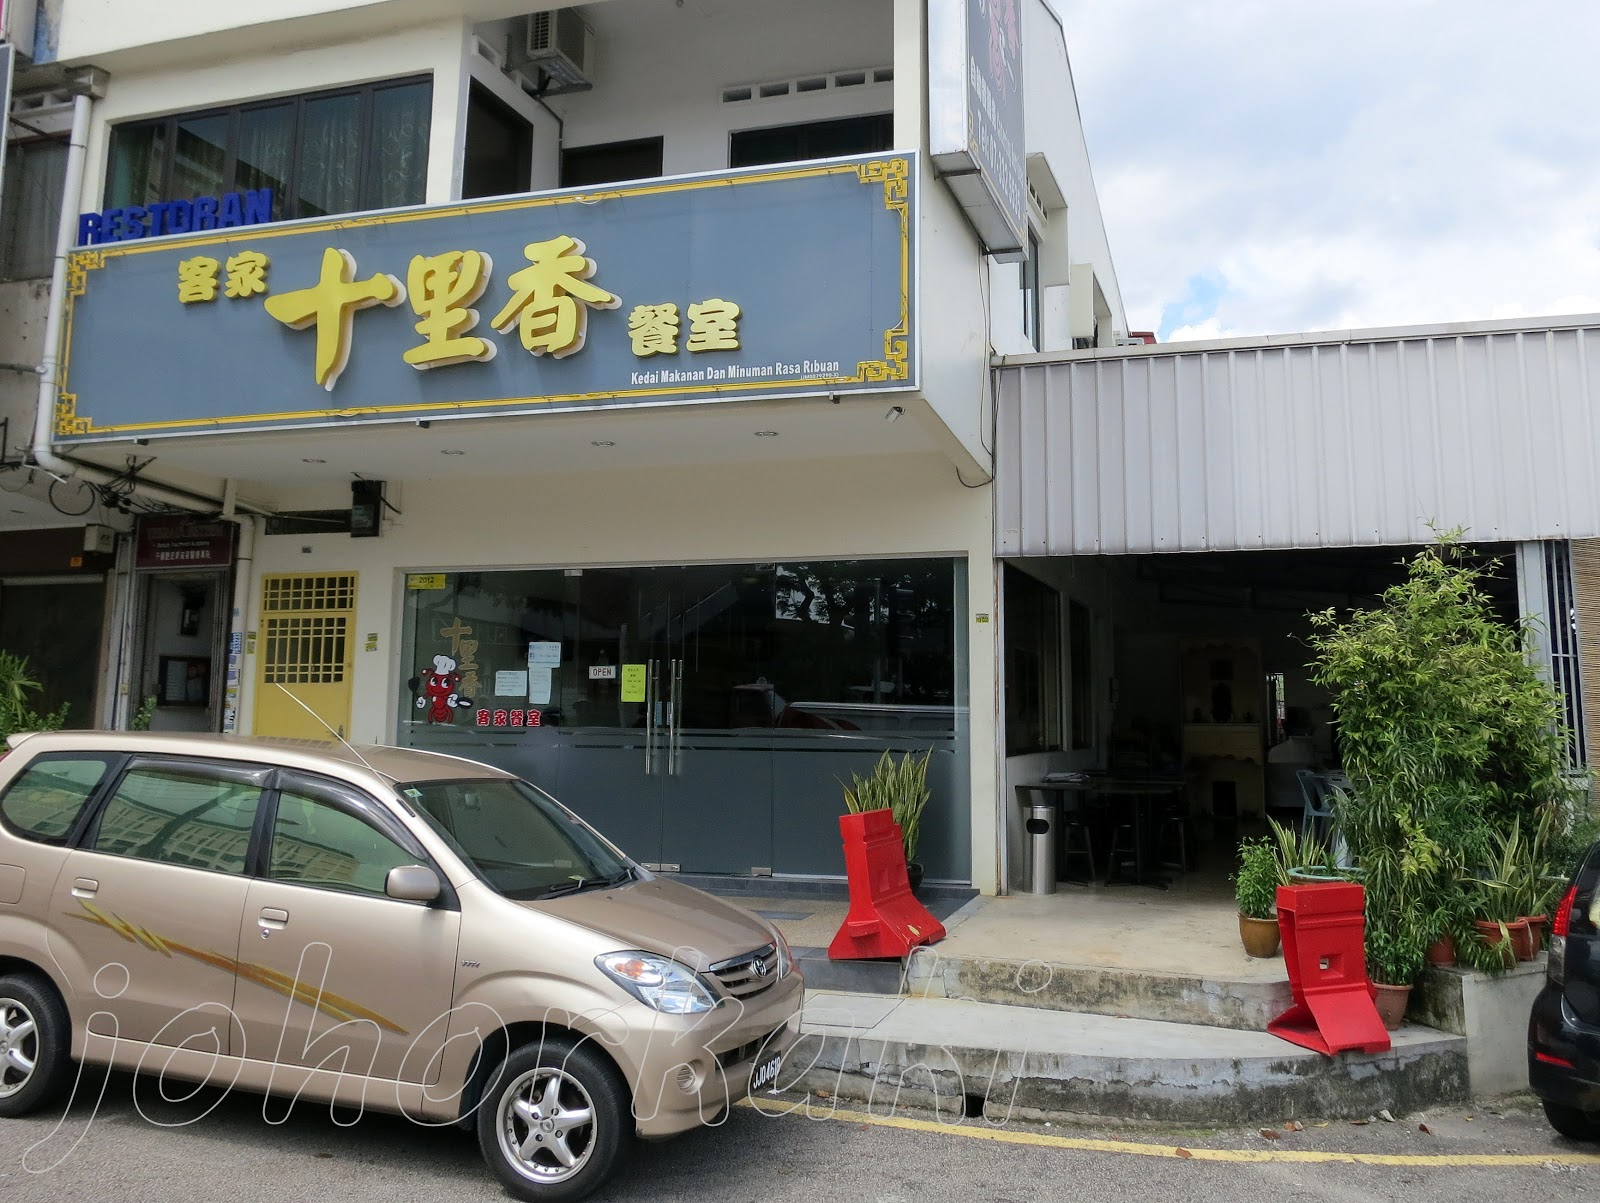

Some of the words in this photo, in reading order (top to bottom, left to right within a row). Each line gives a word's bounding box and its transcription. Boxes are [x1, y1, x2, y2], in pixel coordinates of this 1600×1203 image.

[78, 188, 273, 246] RESTORAN
[178, 250, 271, 304] 客家
[264, 234, 622, 392] 十里香
[627, 298, 742, 358] 餐室
[631, 371, 659, 385] Kedai
[661, 368, 705, 383] Makanan
[707, 366, 726, 380] Dan
[728, 364, 773, 379] Minuman
[775, 362, 801, 376] Rasa
[803, 360, 839, 373] Ribuan
[419, 576, 435, 584] 2012
[592, 666, 612, 677] OPEN
[476, 709, 542, 727] 客家餐室
